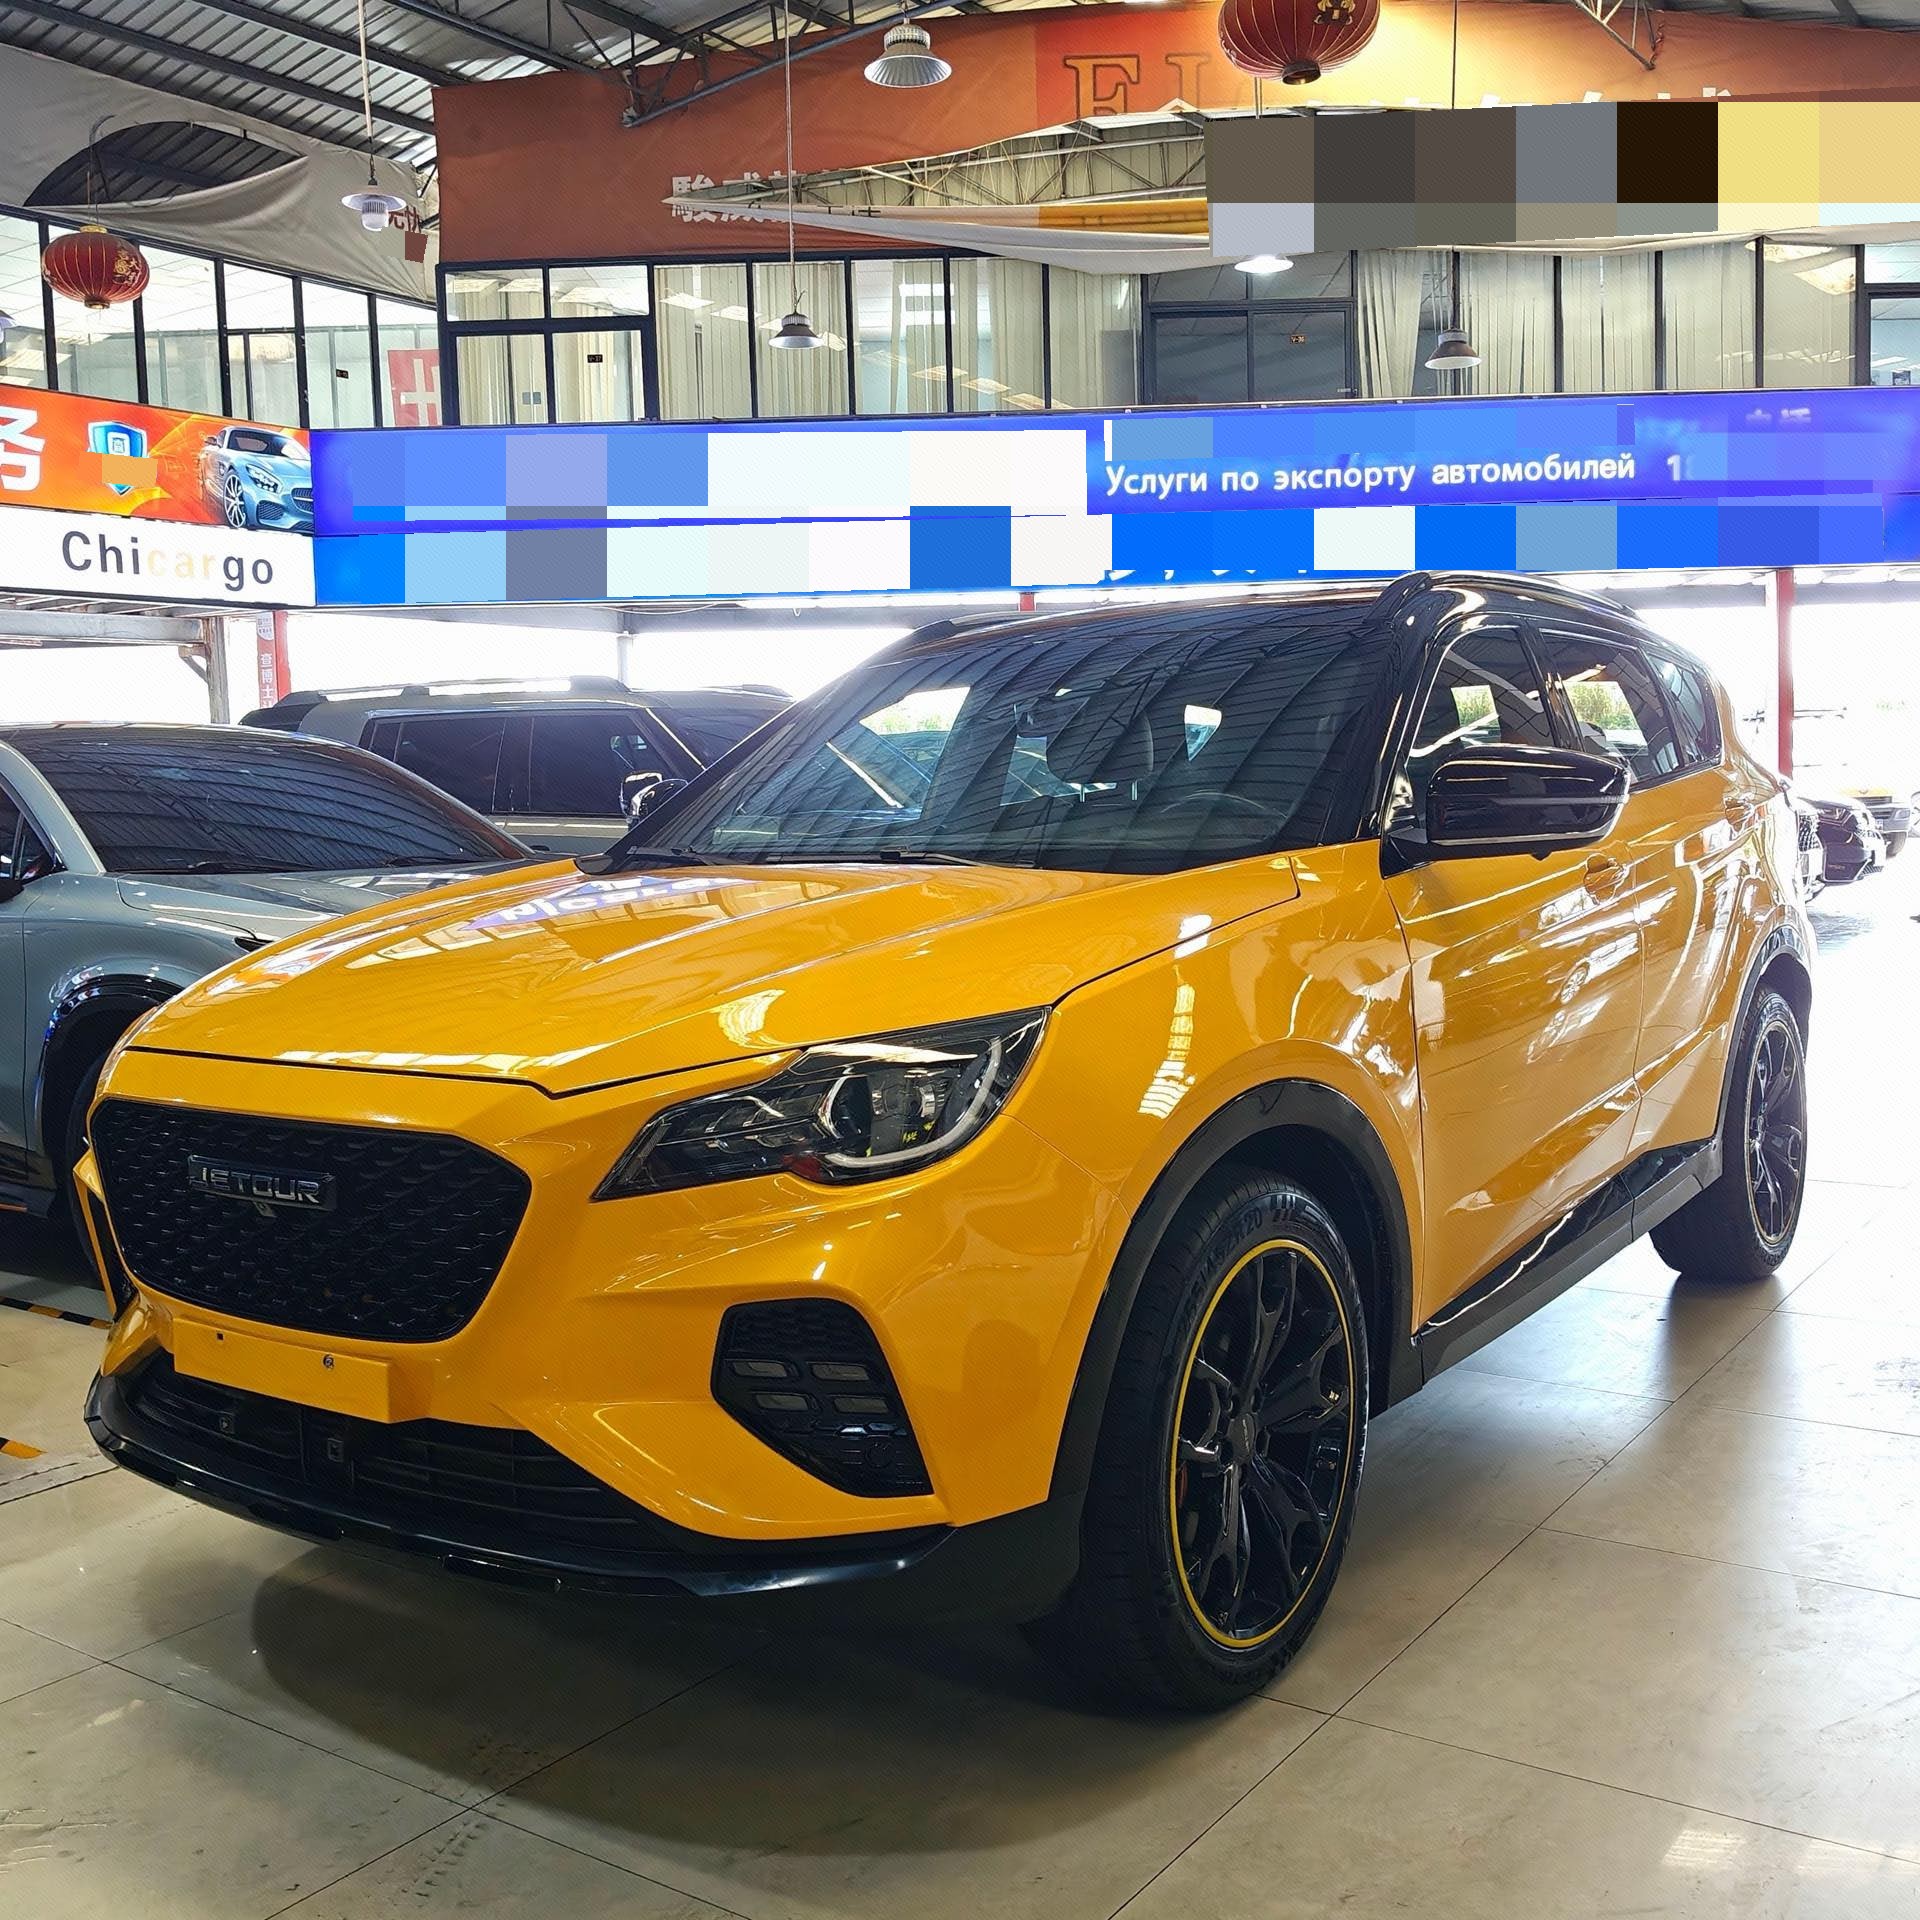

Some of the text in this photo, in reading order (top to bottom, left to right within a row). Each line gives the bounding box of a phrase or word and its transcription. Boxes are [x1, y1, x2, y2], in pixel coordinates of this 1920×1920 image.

[1105, 464, 1207, 501] Услуги
[1222, 471, 1260, 492] по
[1273, 464, 1417, 493] экспорту
[1432, 452, 1636, 485] автомобилей
[62, 531, 274, 592] Chicargo
[190, 1166, 320, 1204] JETOUR
